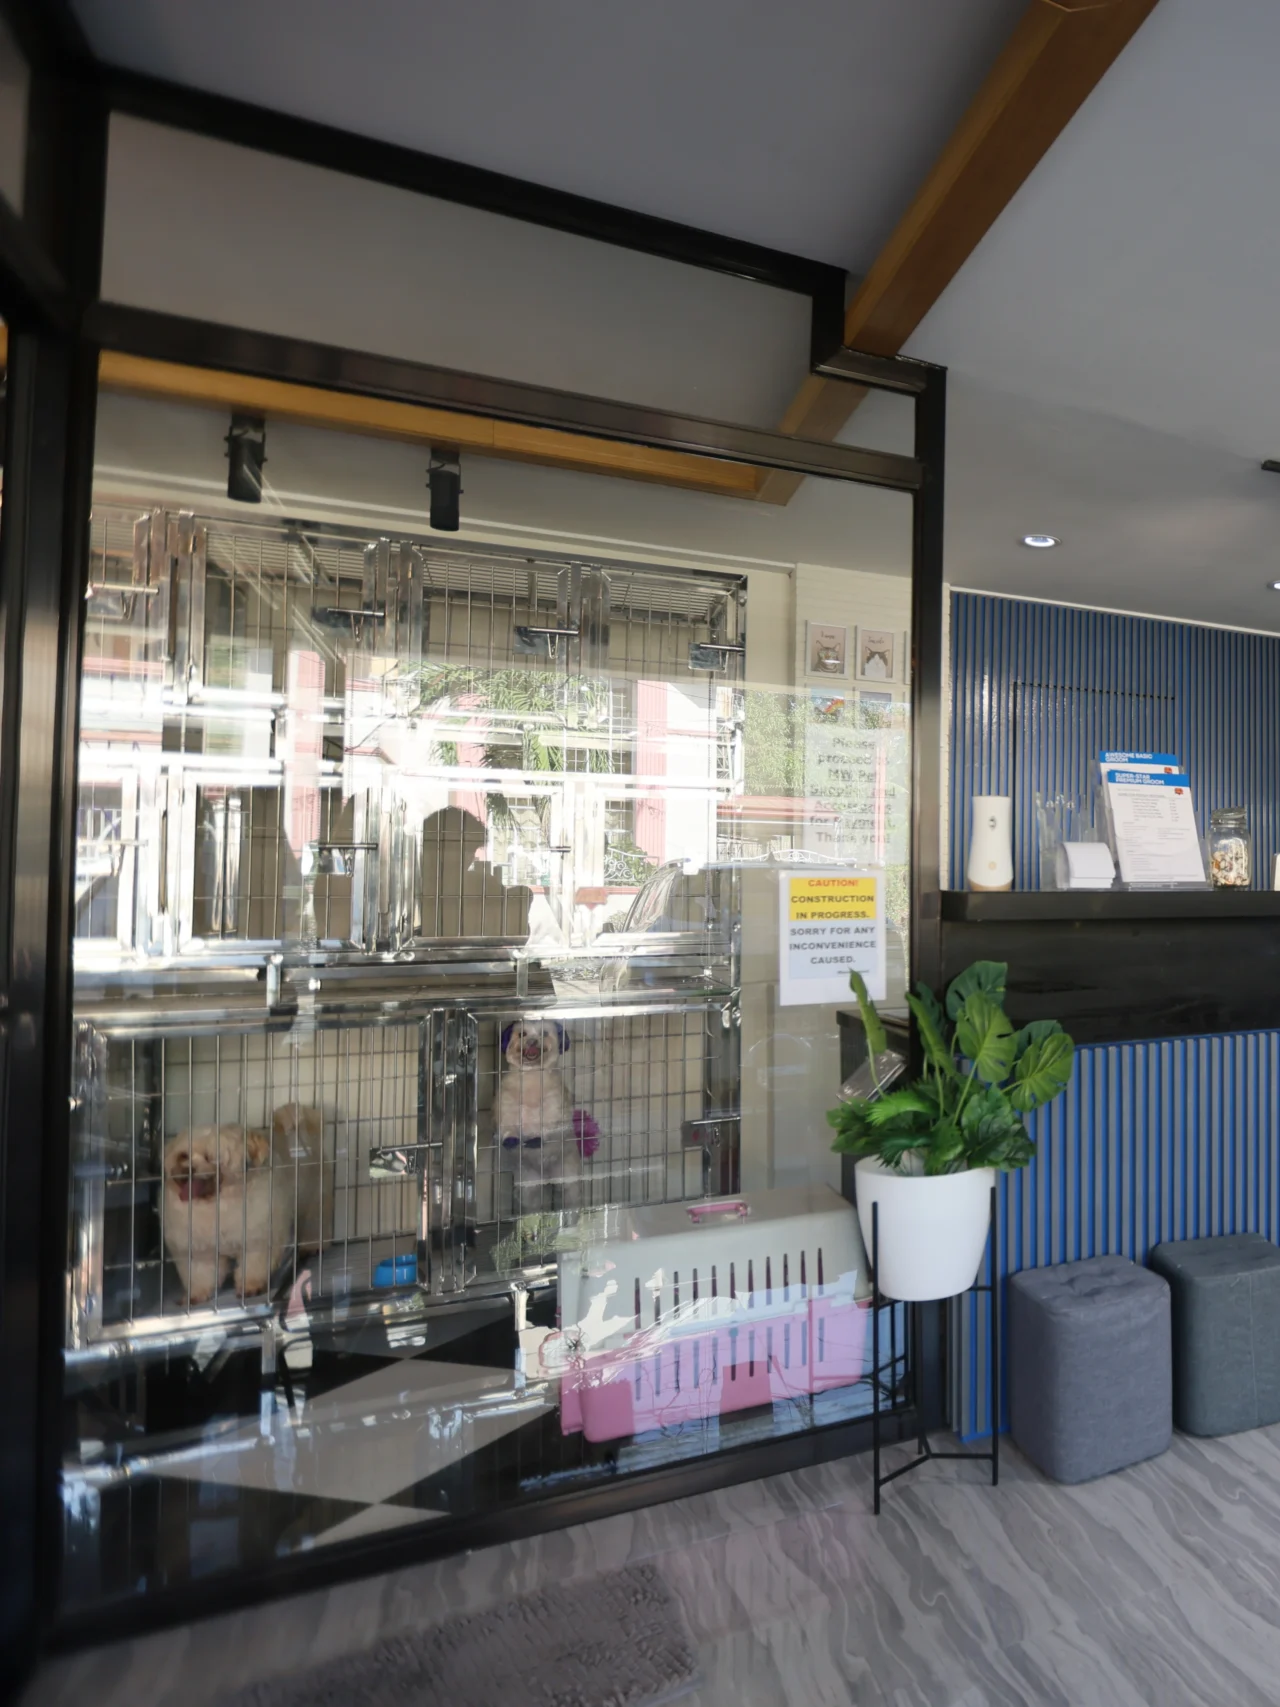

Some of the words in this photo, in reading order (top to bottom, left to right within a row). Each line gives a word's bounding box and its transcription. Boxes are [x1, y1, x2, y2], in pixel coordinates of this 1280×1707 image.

[808, 879, 859, 887] CAUTION!
[790, 895, 875, 903] CONSTRUCTION
[811, 911, 870, 919] PROGRESS.
[790, 928, 826, 936] SORRY
[830, 927, 850, 935] FOR
[853, 926, 875, 934] ANY
[789, 940, 876, 950] INCONVENIENCE
[810, 956, 856, 964] CAUSED.
